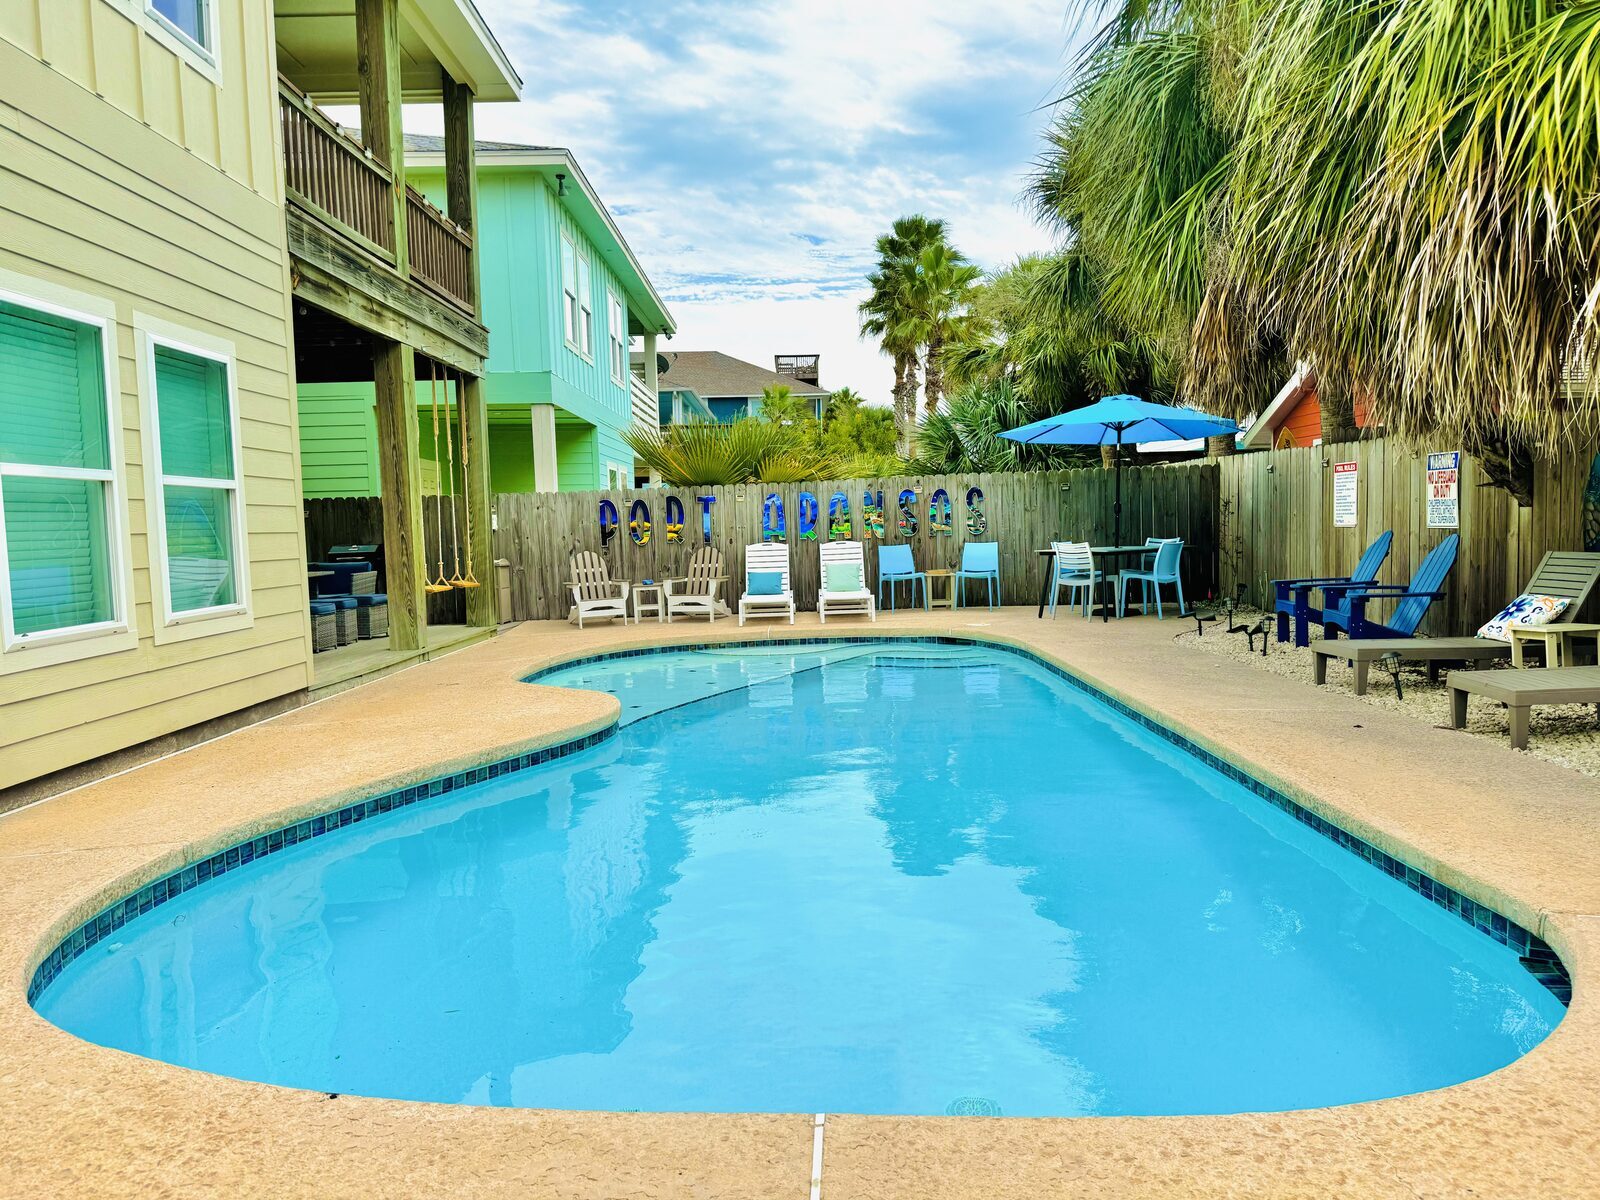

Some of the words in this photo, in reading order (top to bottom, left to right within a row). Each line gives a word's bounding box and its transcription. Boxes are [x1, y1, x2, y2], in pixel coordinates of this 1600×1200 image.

[1429, 453, 1456, 469] WARNING
[1428, 471, 1434, 484] NO
[1434, 470, 1456, 484] LIFEGUARD
[1433, 485, 1439, 498] ON
[1440, 485, 1451, 498] DUTY
[598, 495, 717, 548] PORT
[763, 486, 987, 541] ARANSAS
